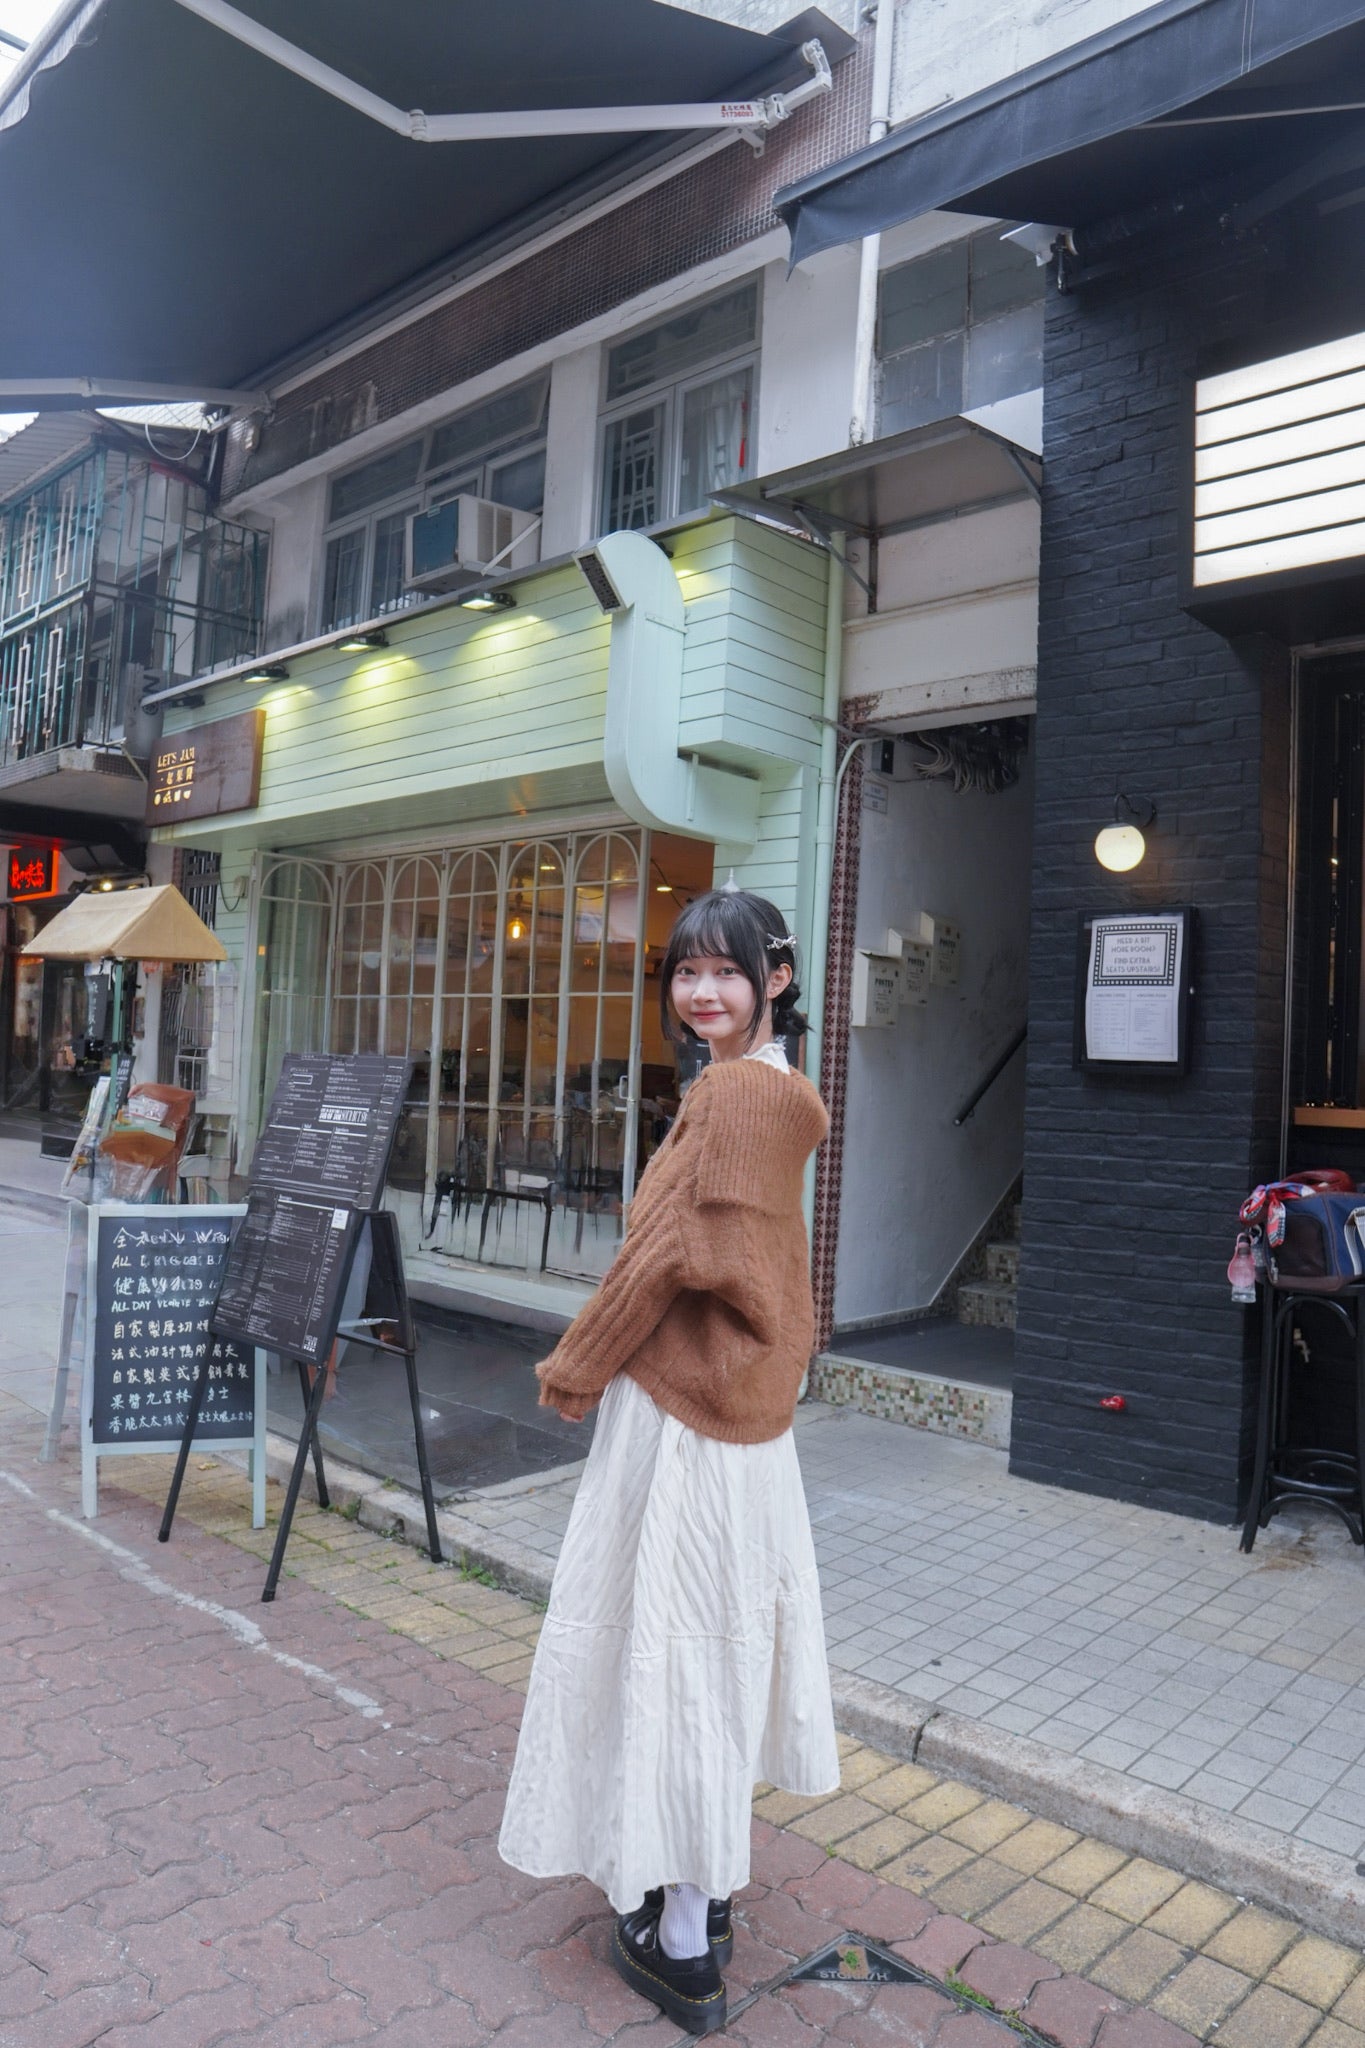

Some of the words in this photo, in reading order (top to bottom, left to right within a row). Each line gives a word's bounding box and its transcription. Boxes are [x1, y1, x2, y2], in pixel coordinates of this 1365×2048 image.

[158, 752, 177, 767] LET'S
[1117, 937, 1134, 945] NEED
[1141, 936, 1151, 944] BIT
[1111, 945, 1129, 953] MORE
[1130, 945, 1156, 953] ROOM?
[112, 1254, 132, 1269] ALL
[111, 1299, 130, 1314] ALL
[132, 1299, 152, 1311] DAY
